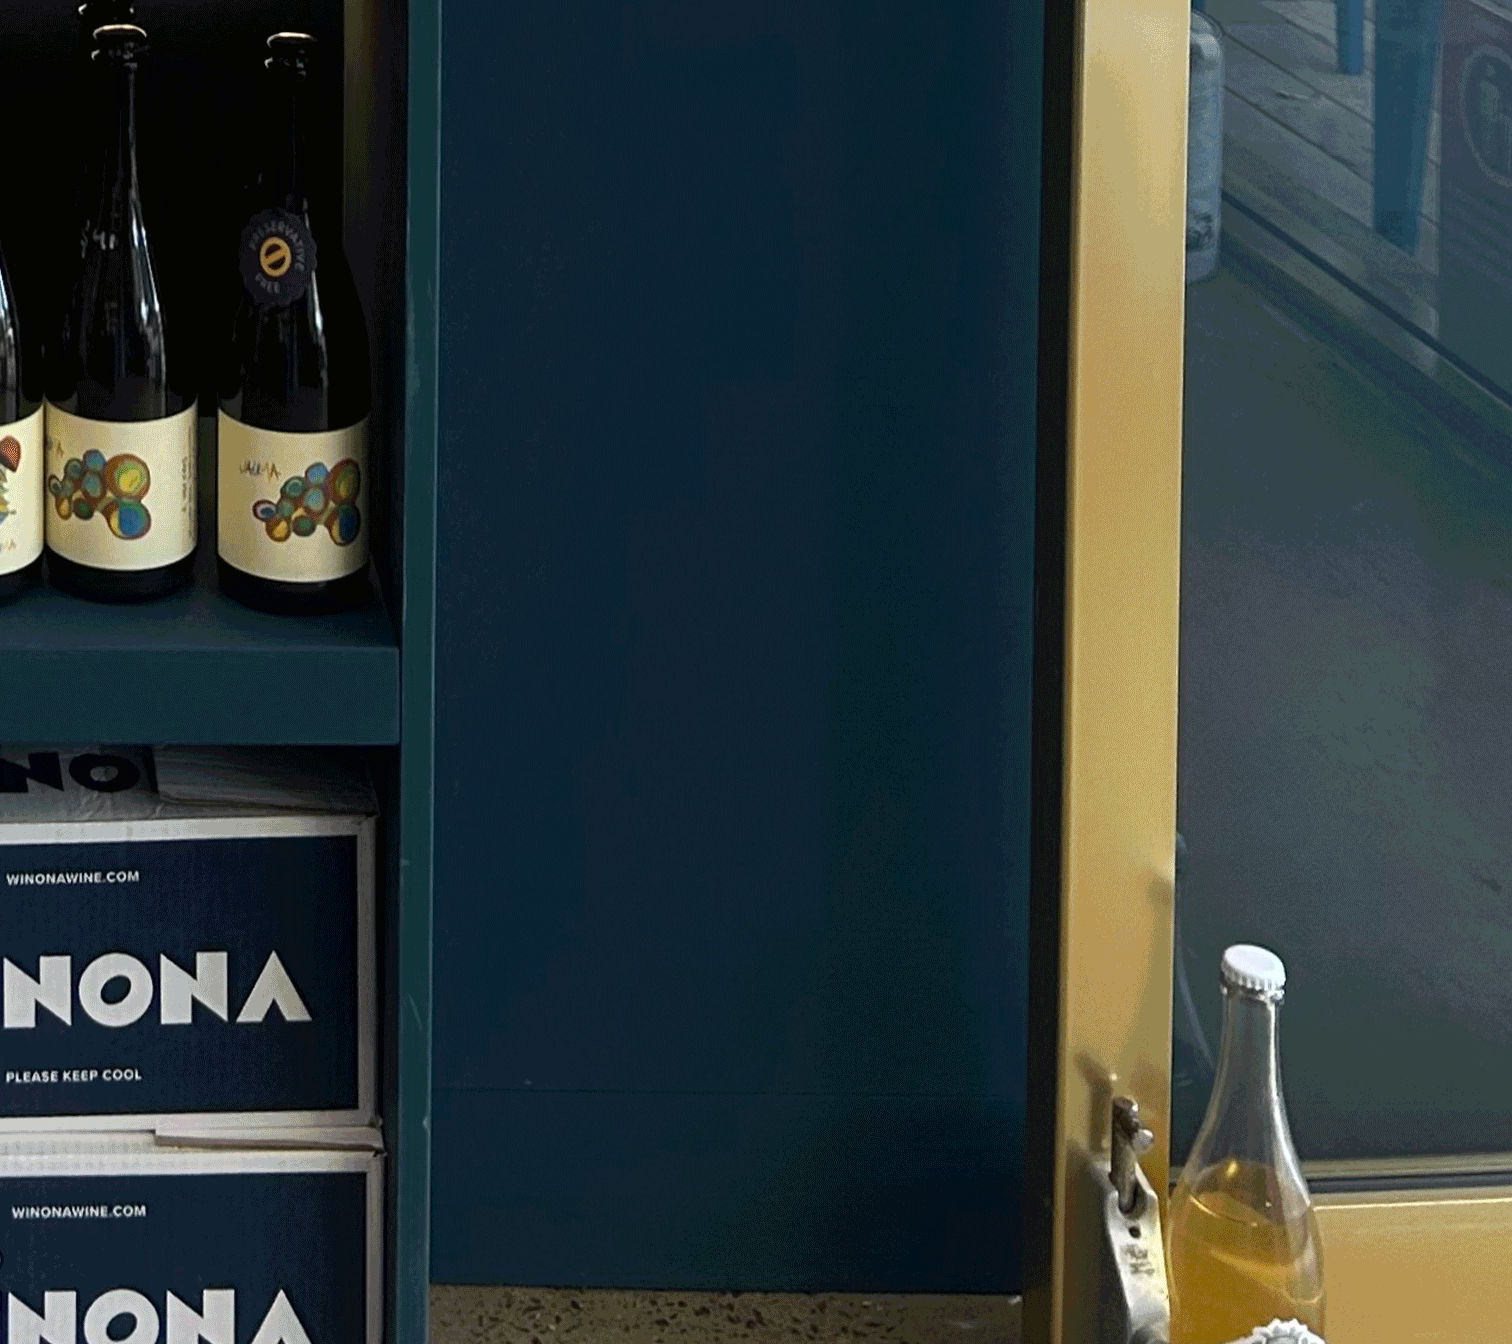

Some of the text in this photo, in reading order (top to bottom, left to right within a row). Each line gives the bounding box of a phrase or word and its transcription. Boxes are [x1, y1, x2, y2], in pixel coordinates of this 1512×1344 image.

[6, 870, 140, 886] WINONAWINE.COM
[6, 1068, 142, 1083] PLEASE KEEP COOL
[11, 1205, 147, 1220] WINONAWINE.COM
